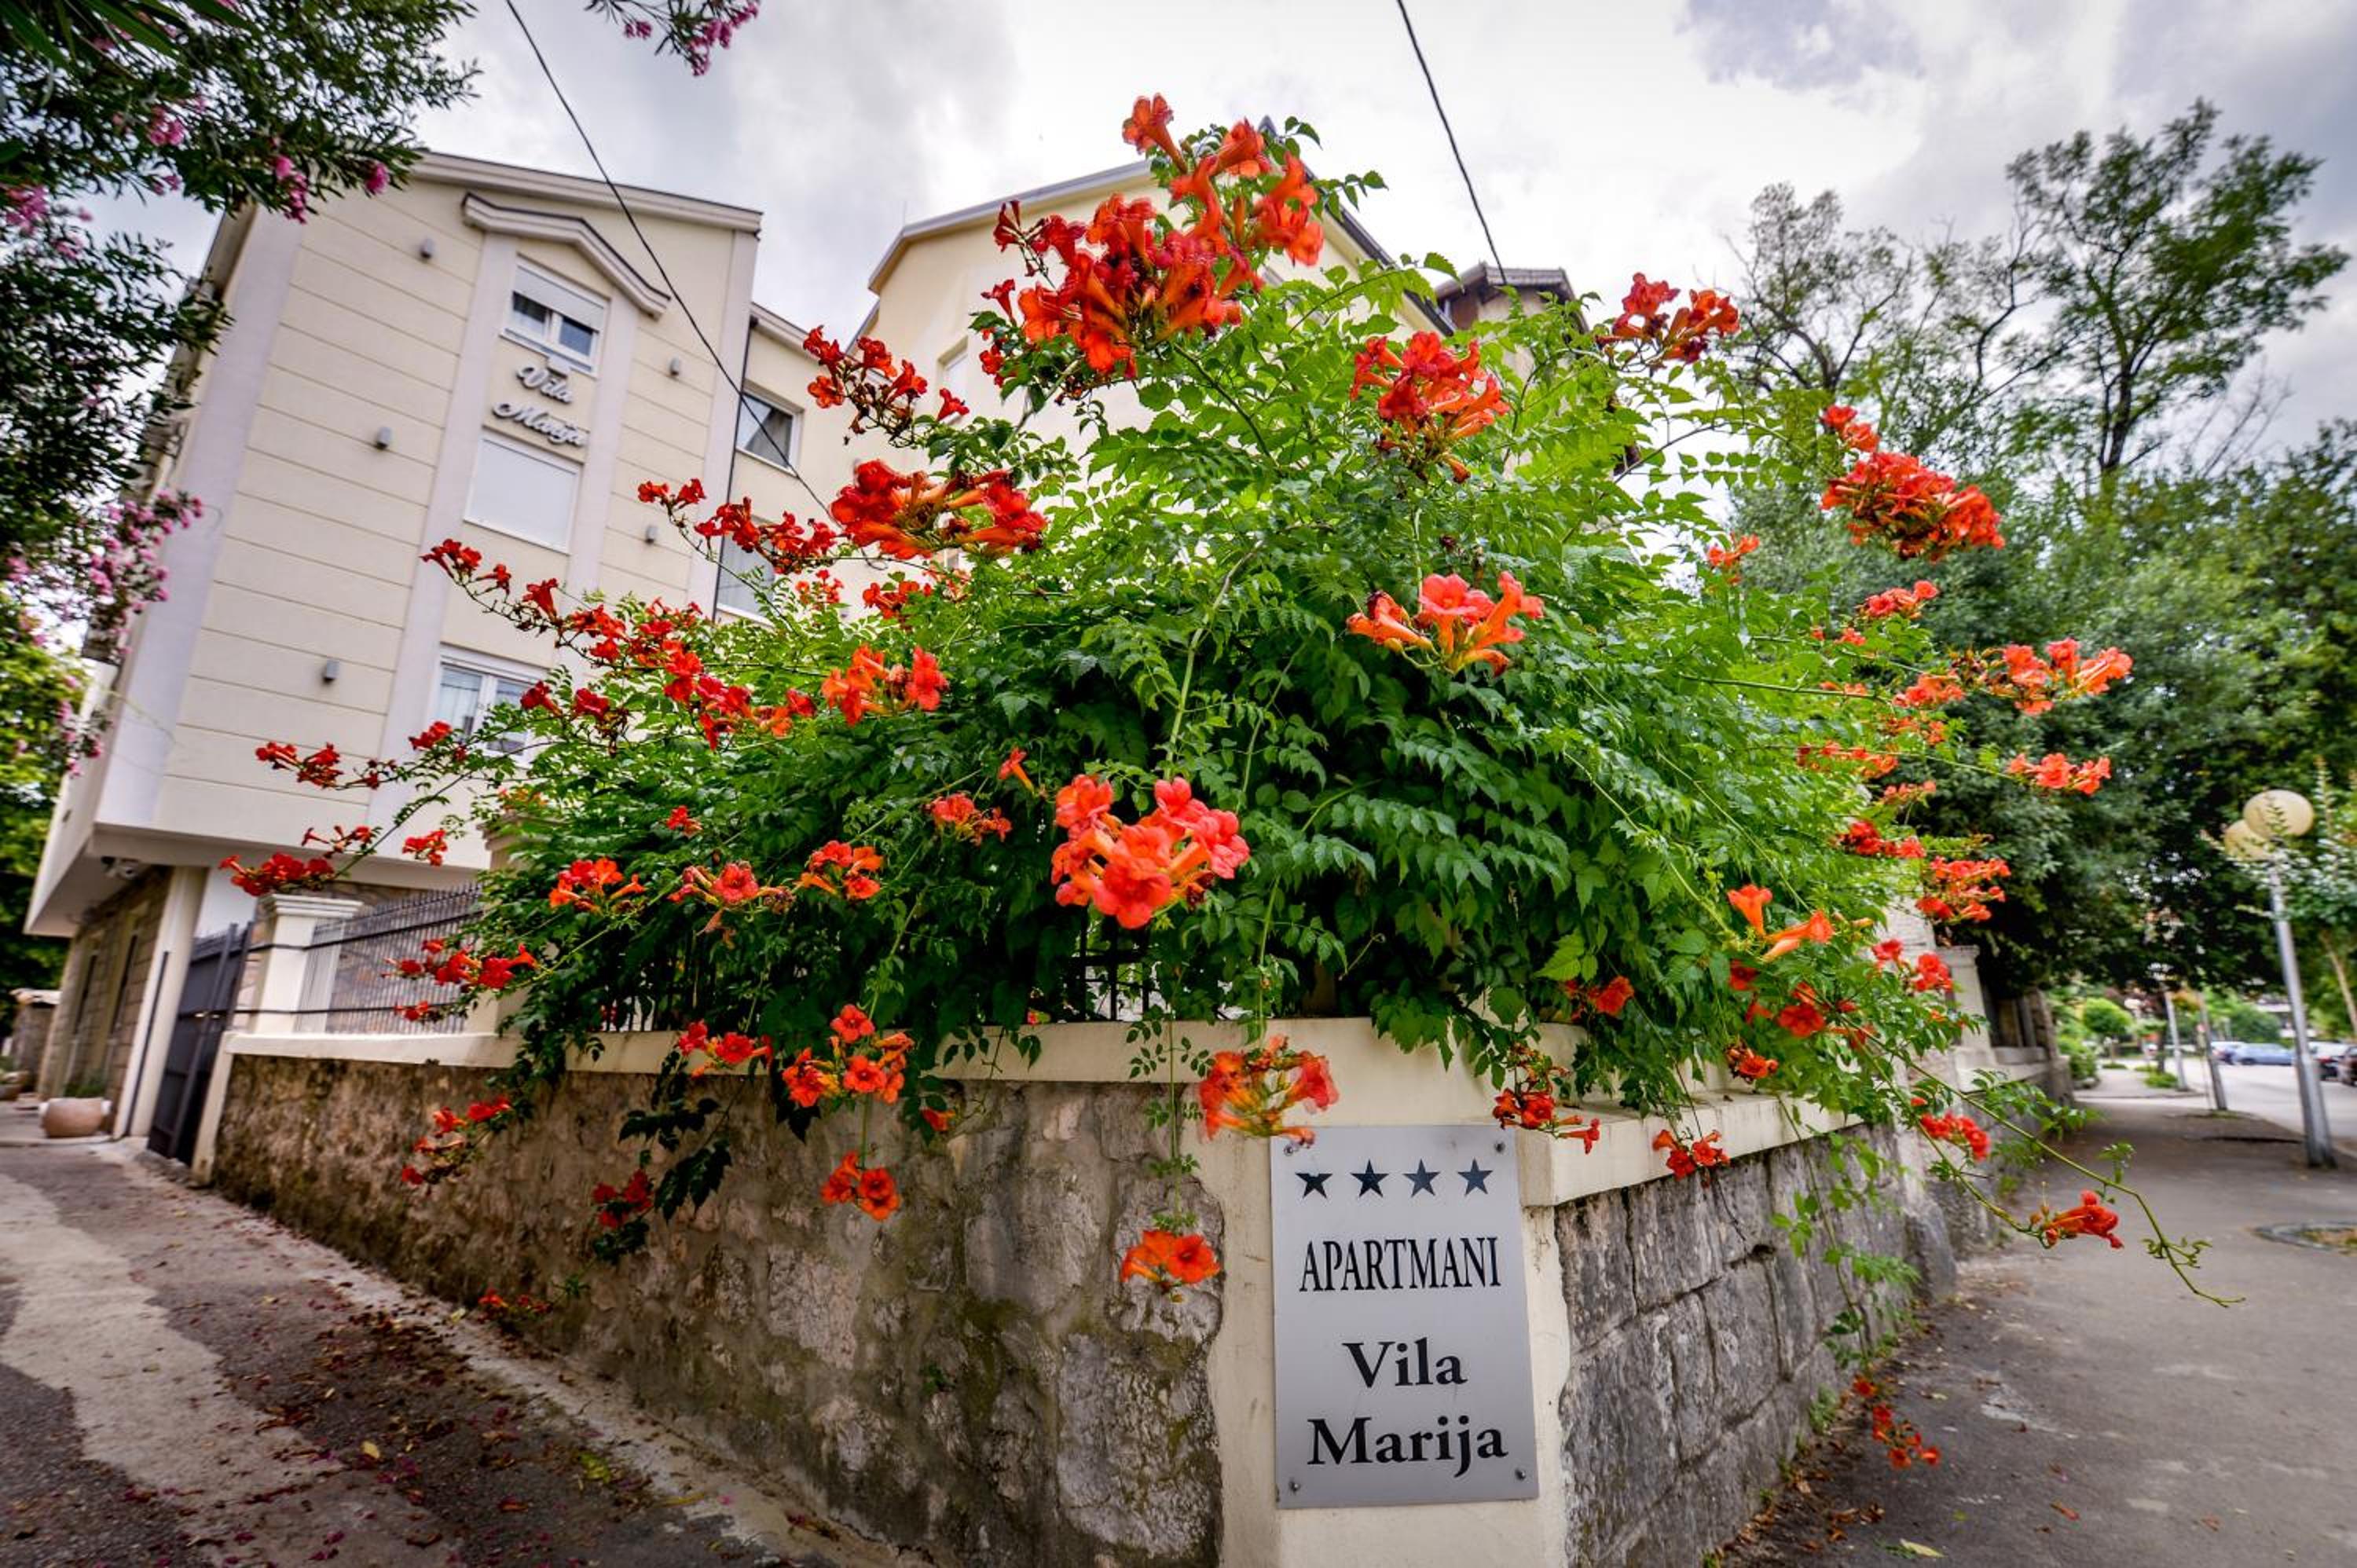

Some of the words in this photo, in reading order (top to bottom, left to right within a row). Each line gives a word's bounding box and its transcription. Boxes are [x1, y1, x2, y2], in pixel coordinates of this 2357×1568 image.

[515, 366, 573, 405] Vila
[492, 403, 587, 447] Marija
[1299, 1236, 1501, 1292] APARTMANI
[1342, 1337, 1468, 1389] Vila
[1307, 1415, 1508, 1478] Marija
